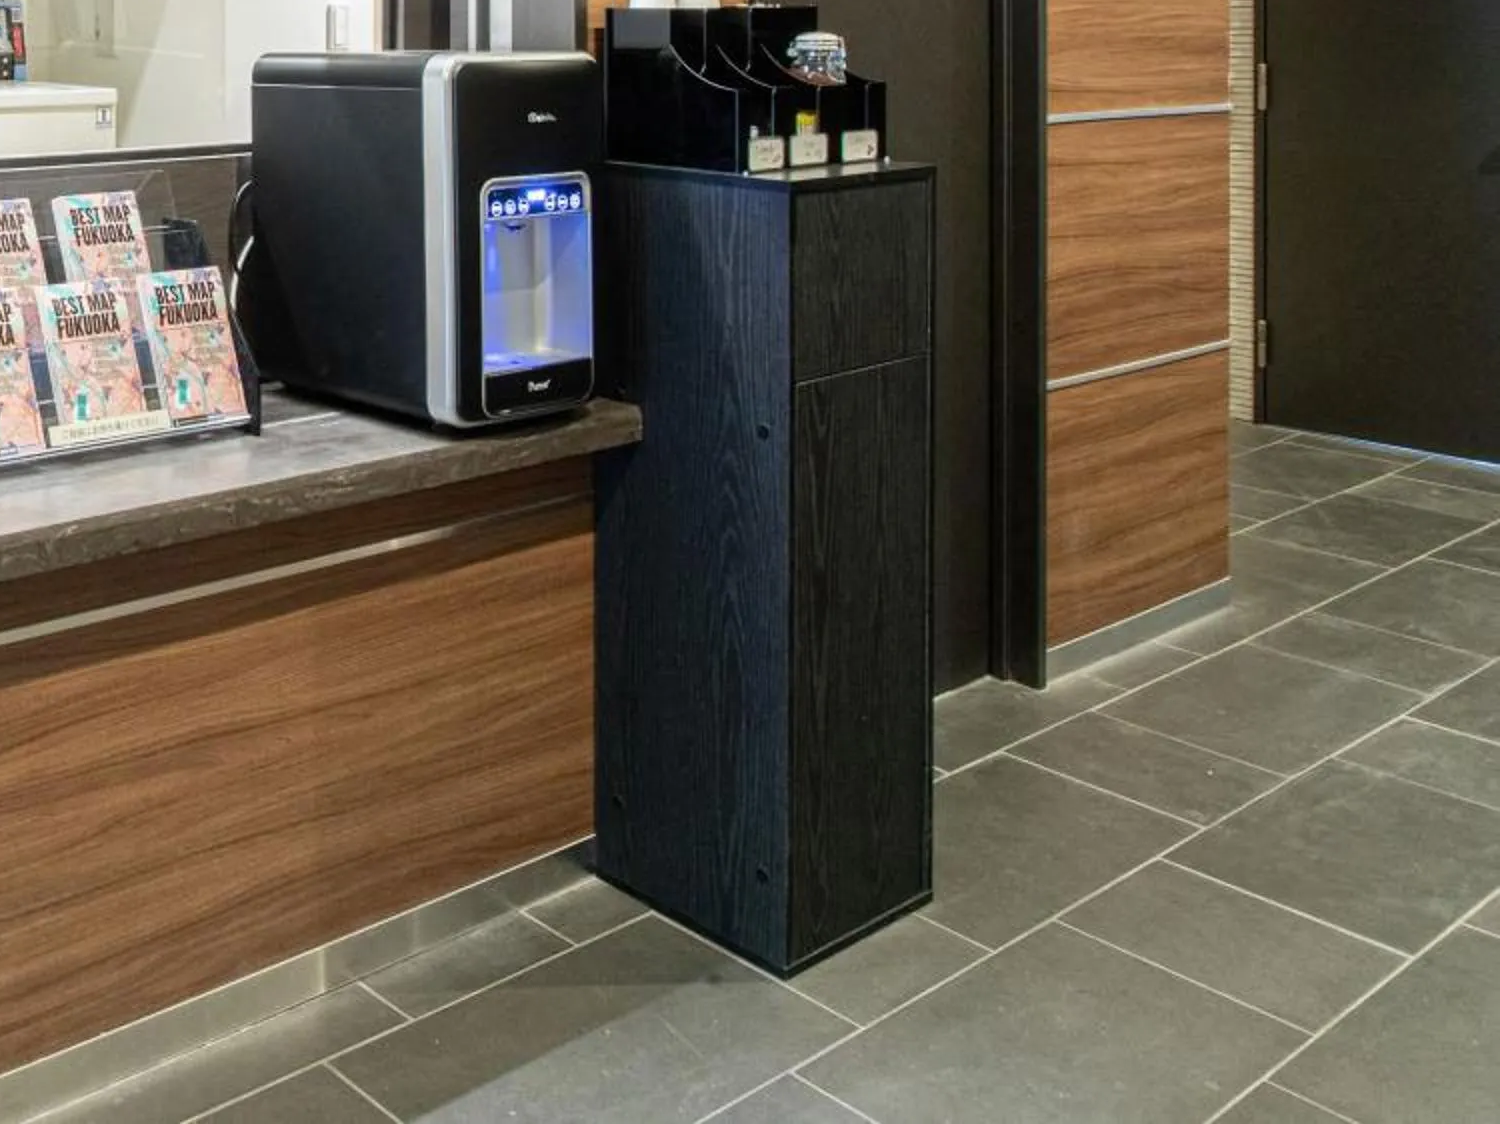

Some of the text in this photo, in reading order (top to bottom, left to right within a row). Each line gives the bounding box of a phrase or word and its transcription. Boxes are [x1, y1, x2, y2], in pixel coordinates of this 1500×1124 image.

[70, 204, 131, 227] BEST MAP
[74, 223, 135, 247] FUKUOKA
[52, 291, 118, 317] BEST MAP
[155, 280, 216, 305] BEST MAP
[159, 300, 219, 327] FUKUOKA
[57, 314, 121, 340] FUKUOKA
